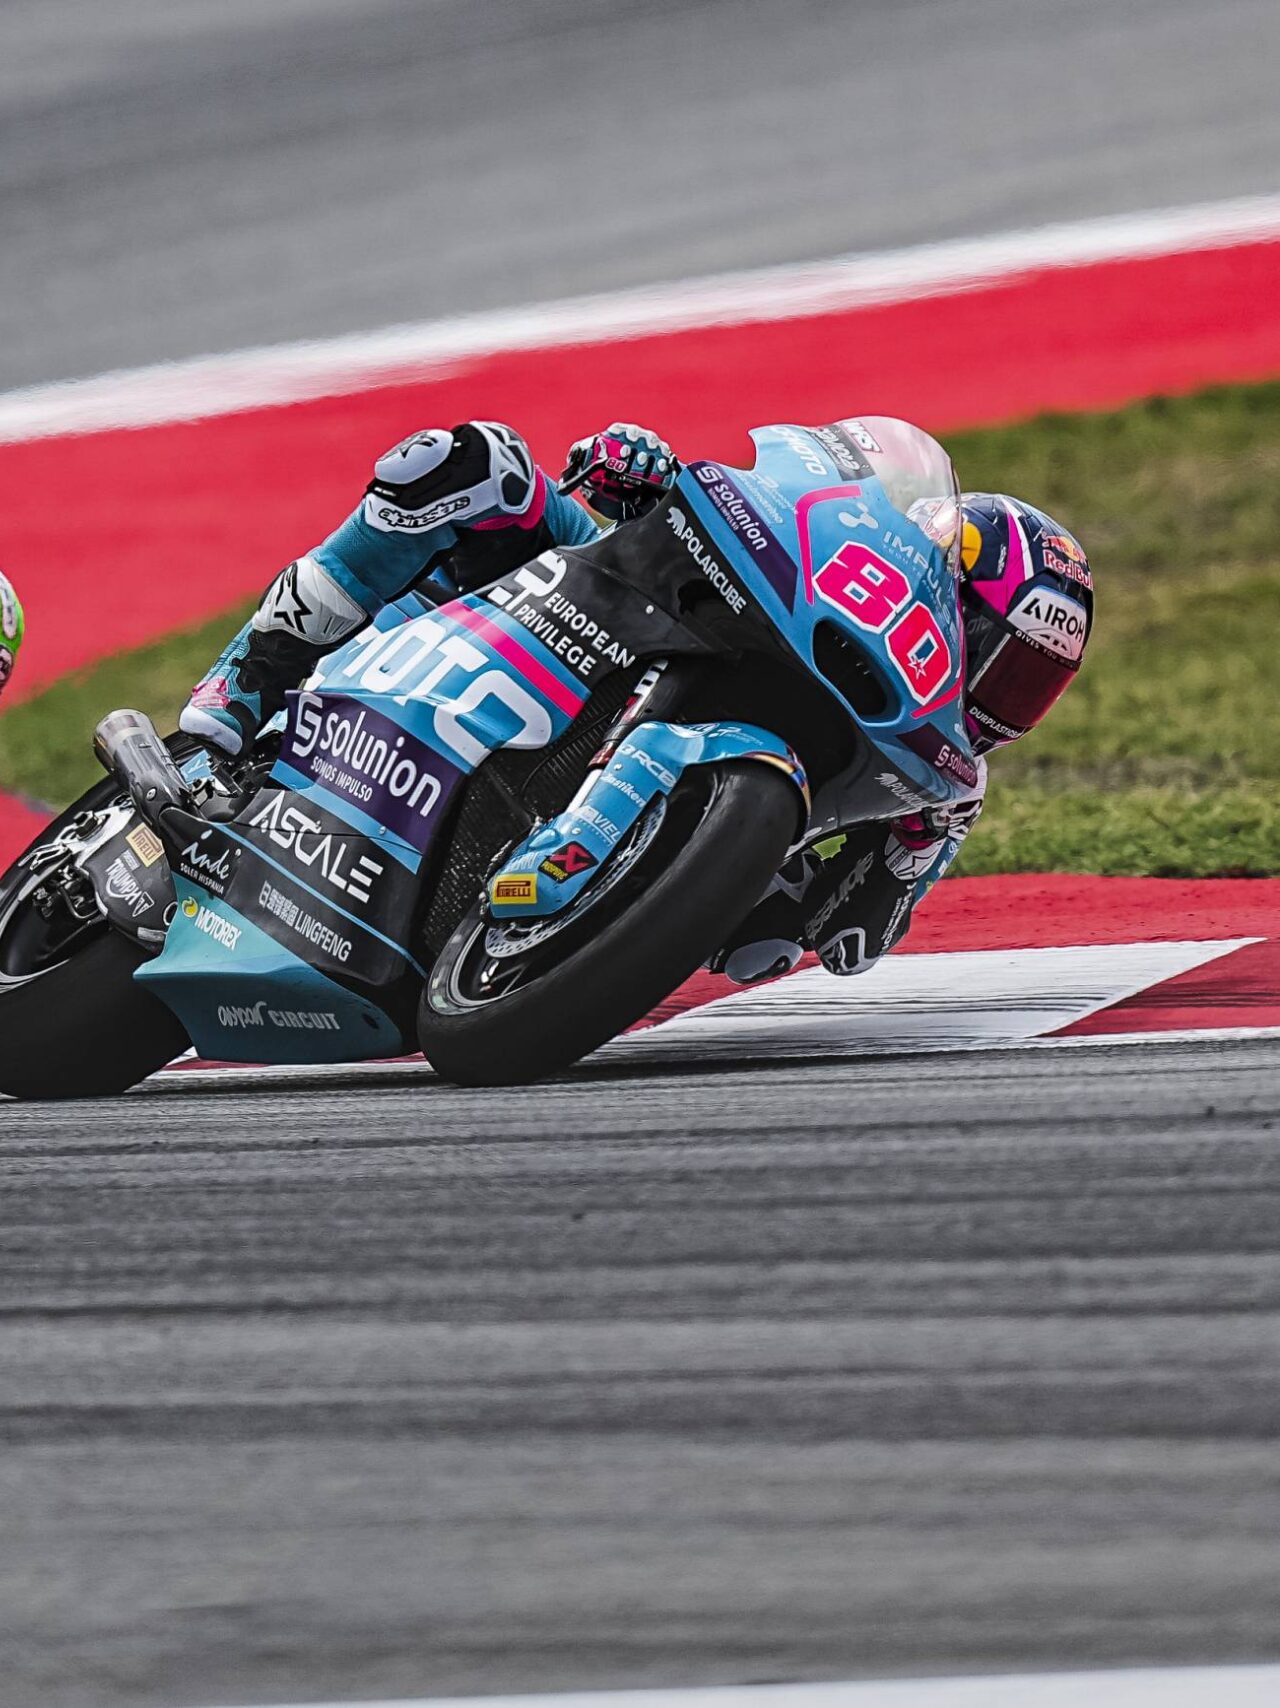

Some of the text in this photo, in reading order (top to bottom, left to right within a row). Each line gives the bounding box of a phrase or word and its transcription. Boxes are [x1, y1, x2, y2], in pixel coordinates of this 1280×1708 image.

[606, 457, 627, 472] 80
[378, 496, 471, 528] alpinestars
[714, 483, 768, 551] solunion
[681, 526, 747, 615] POLARCUBE
[1043, 549, 1094, 592] Red Bul
[514, 604, 597, 676] PRIVILEGE
[543, 592, 636, 669] EUROPEAN
[812, 540, 952, 706] 80
[1022, 597, 1086, 643] AIROH
[310, 756, 374, 803] SOMOS IMPULSO
[320, 710, 442, 818] solunion
[248, 789, 384, 904] ASCALE
[104, 857, 144, 906] TRIUMPH
[180, 862, 225, 895] SOLER HISPANIA
[498, 881, 532, 898] PIRELLI
[194, 905, 243, 951] MOTOREX
[294, 910, 352, 962] LINGFENG
[268, 1009, 341, 1031] CIRCUIT
